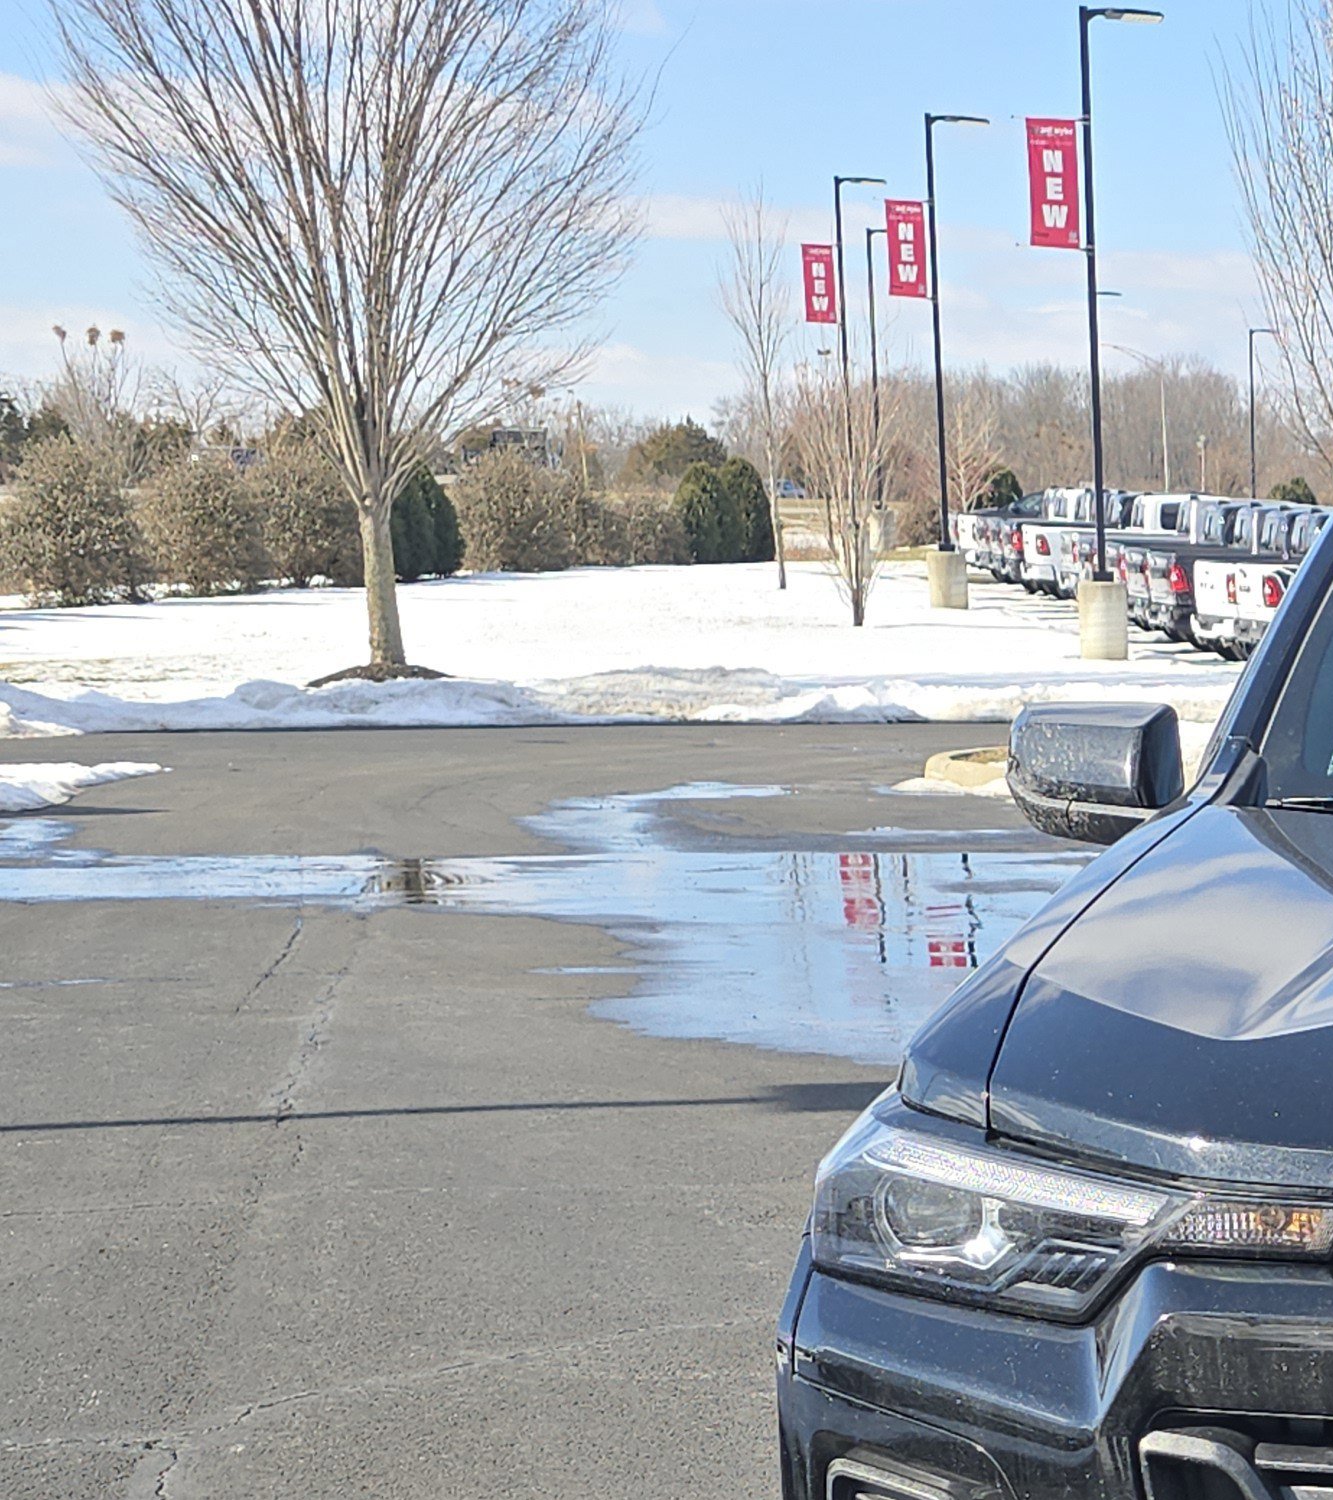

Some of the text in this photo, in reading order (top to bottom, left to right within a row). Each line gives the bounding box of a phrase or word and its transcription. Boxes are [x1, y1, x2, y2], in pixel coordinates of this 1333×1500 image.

[1042, 149, 1068, 229] NEW
[897, 222, 918, 283] NEW
[811, 262, 828, 312] NEW
